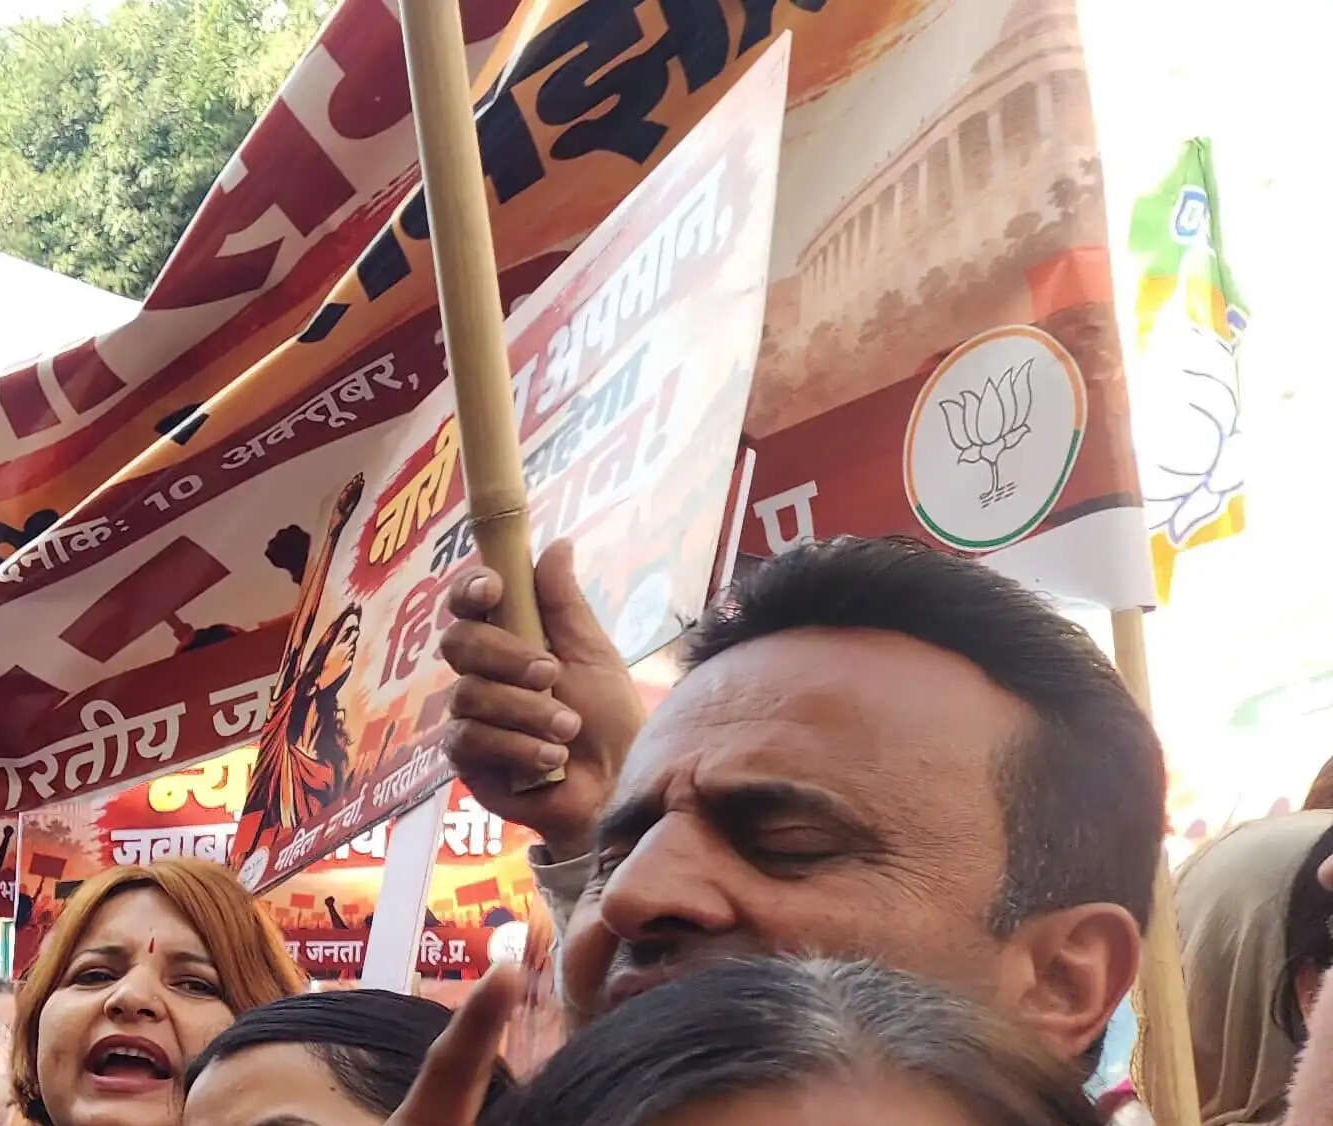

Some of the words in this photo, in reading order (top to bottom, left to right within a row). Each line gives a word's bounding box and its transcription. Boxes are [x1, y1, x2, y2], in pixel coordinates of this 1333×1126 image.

[144, 475, 204, 513] 10
[220, 352, 420, 473] अक्तूबर,
[368, 413, 460, 566] नारी
[535, 157, 734, 416] अपमान,
[305, 939, 365, 964] जनता
